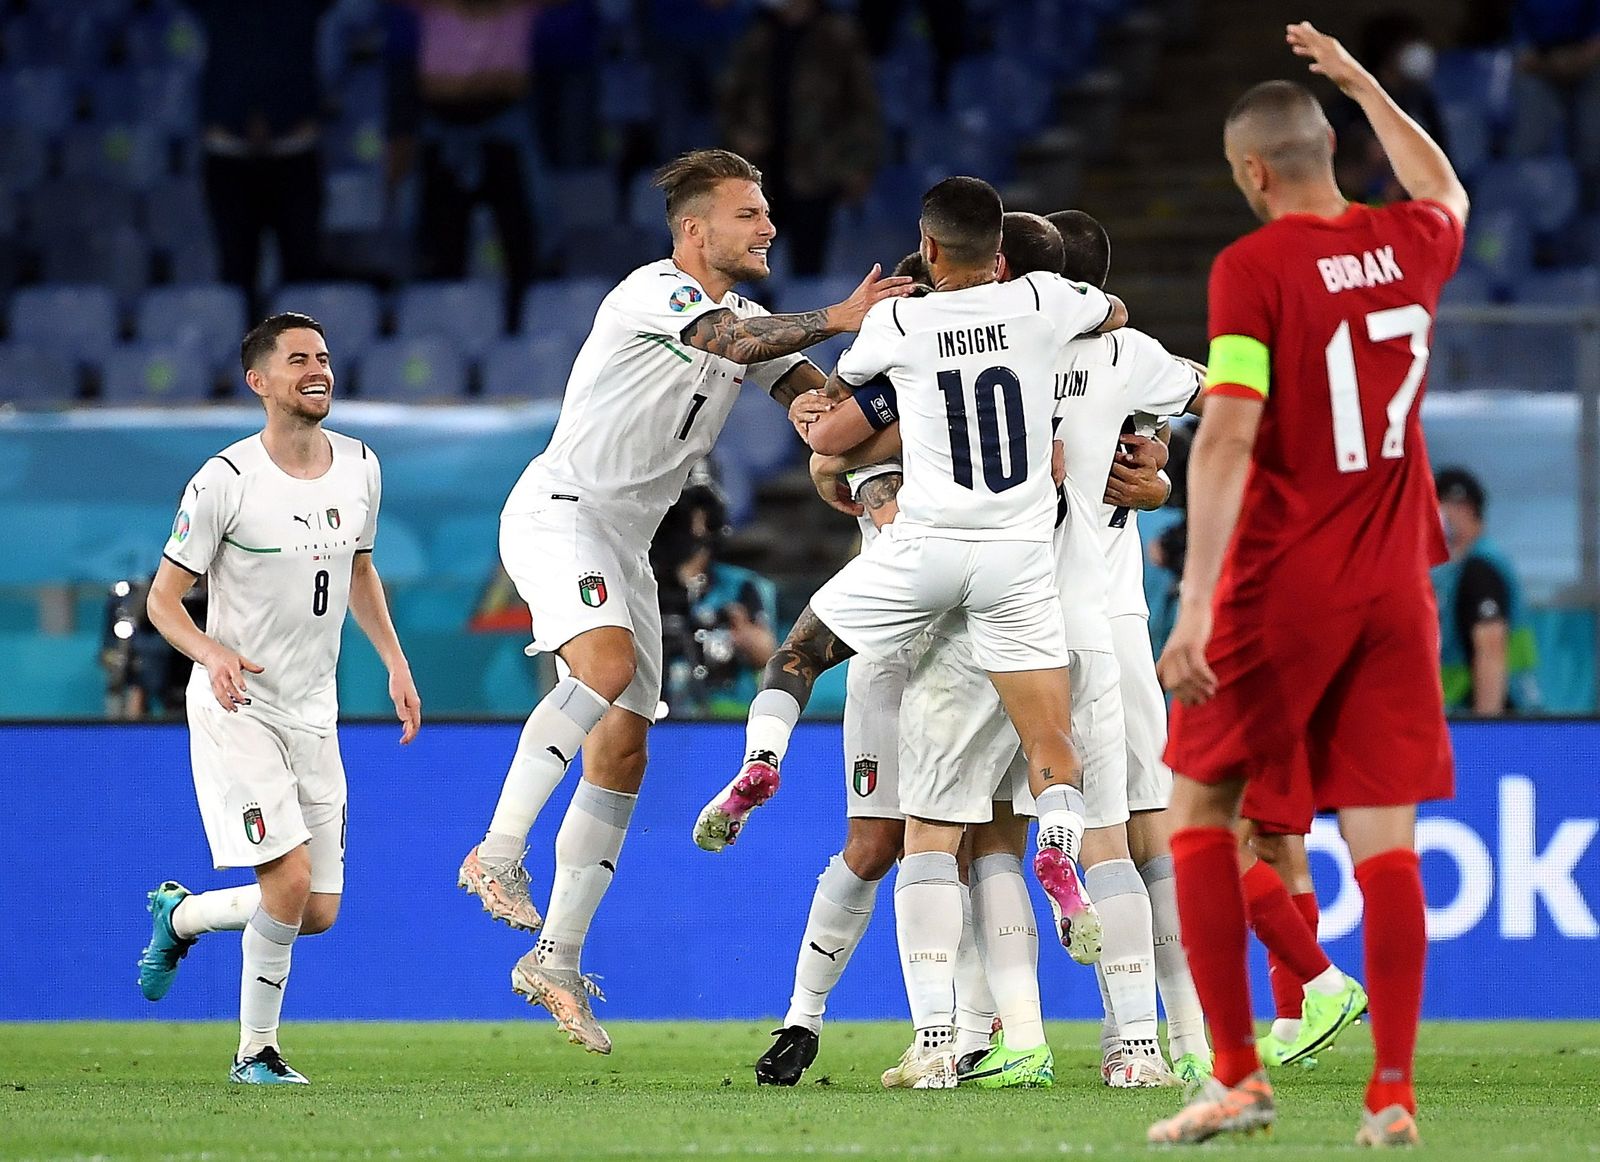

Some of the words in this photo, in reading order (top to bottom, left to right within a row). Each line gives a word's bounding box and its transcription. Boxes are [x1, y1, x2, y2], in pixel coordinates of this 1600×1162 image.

[1316, 245, 1404, 293] BURAK
[937, 324, 1009, 358] INSIGNE
[1325, 304, 1432, 473] 17
[937, 366, 1027, 494] 10
[313, 570, 329, 616] 8
[909, 952, 947, 962] ITALIA
